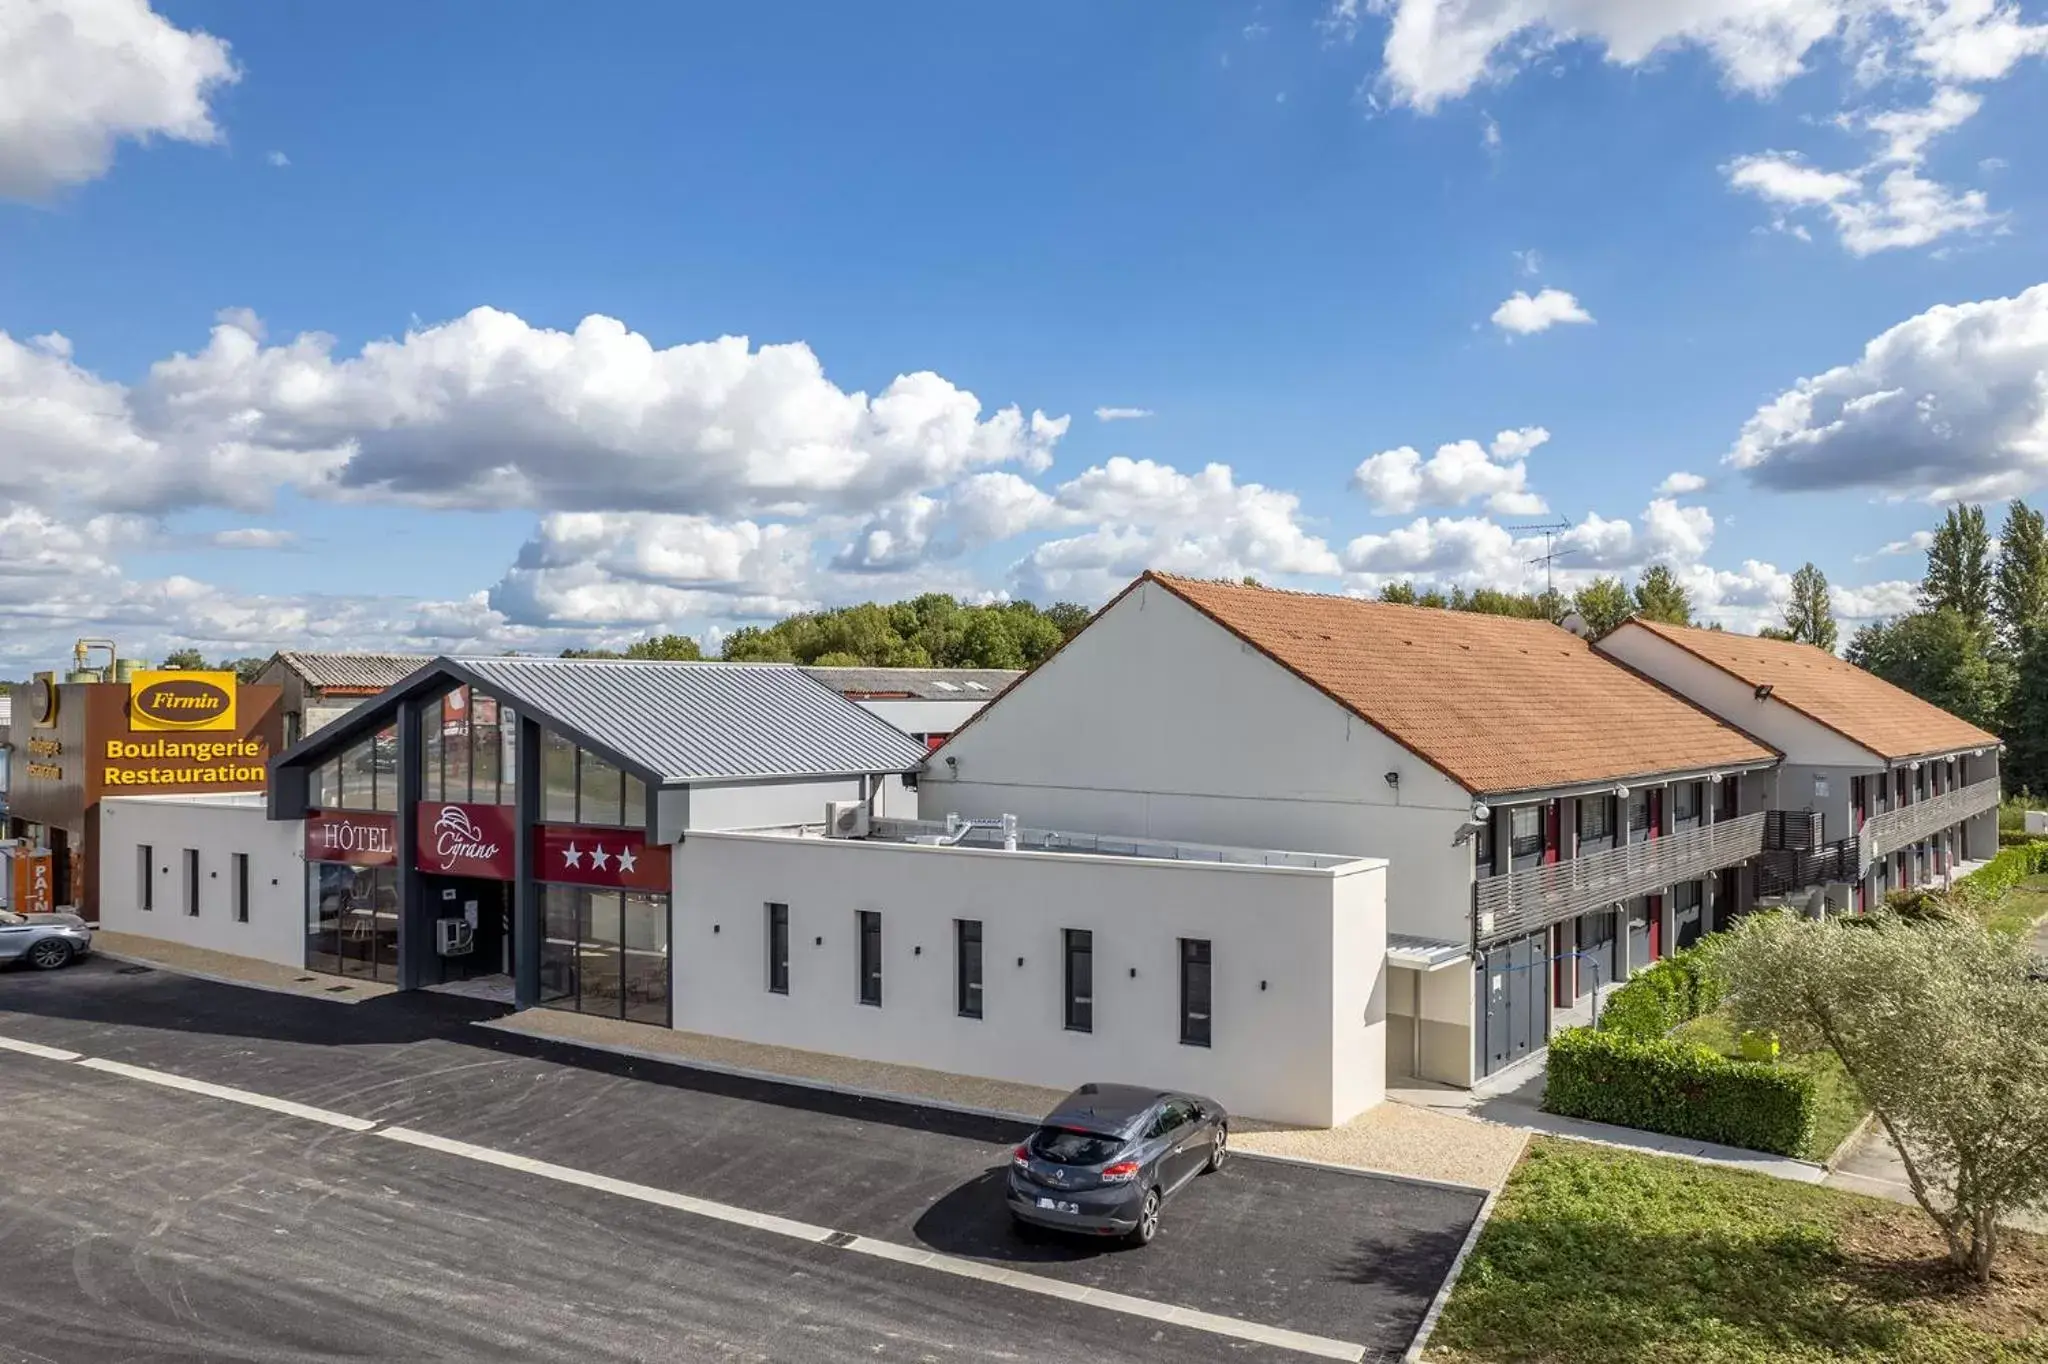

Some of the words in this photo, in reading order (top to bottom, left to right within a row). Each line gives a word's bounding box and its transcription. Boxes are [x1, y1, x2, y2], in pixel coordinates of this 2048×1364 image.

[151, 692, 219, 709] Firmin
[107, 739, 259, 761] Boulangerie
[104, 764, 264, 785] Restauration
[323, 820, 393, 853] HÔTEL
[437, 831, 499, 870] Cyrano
[35, 865, 48, 911] PAIN
